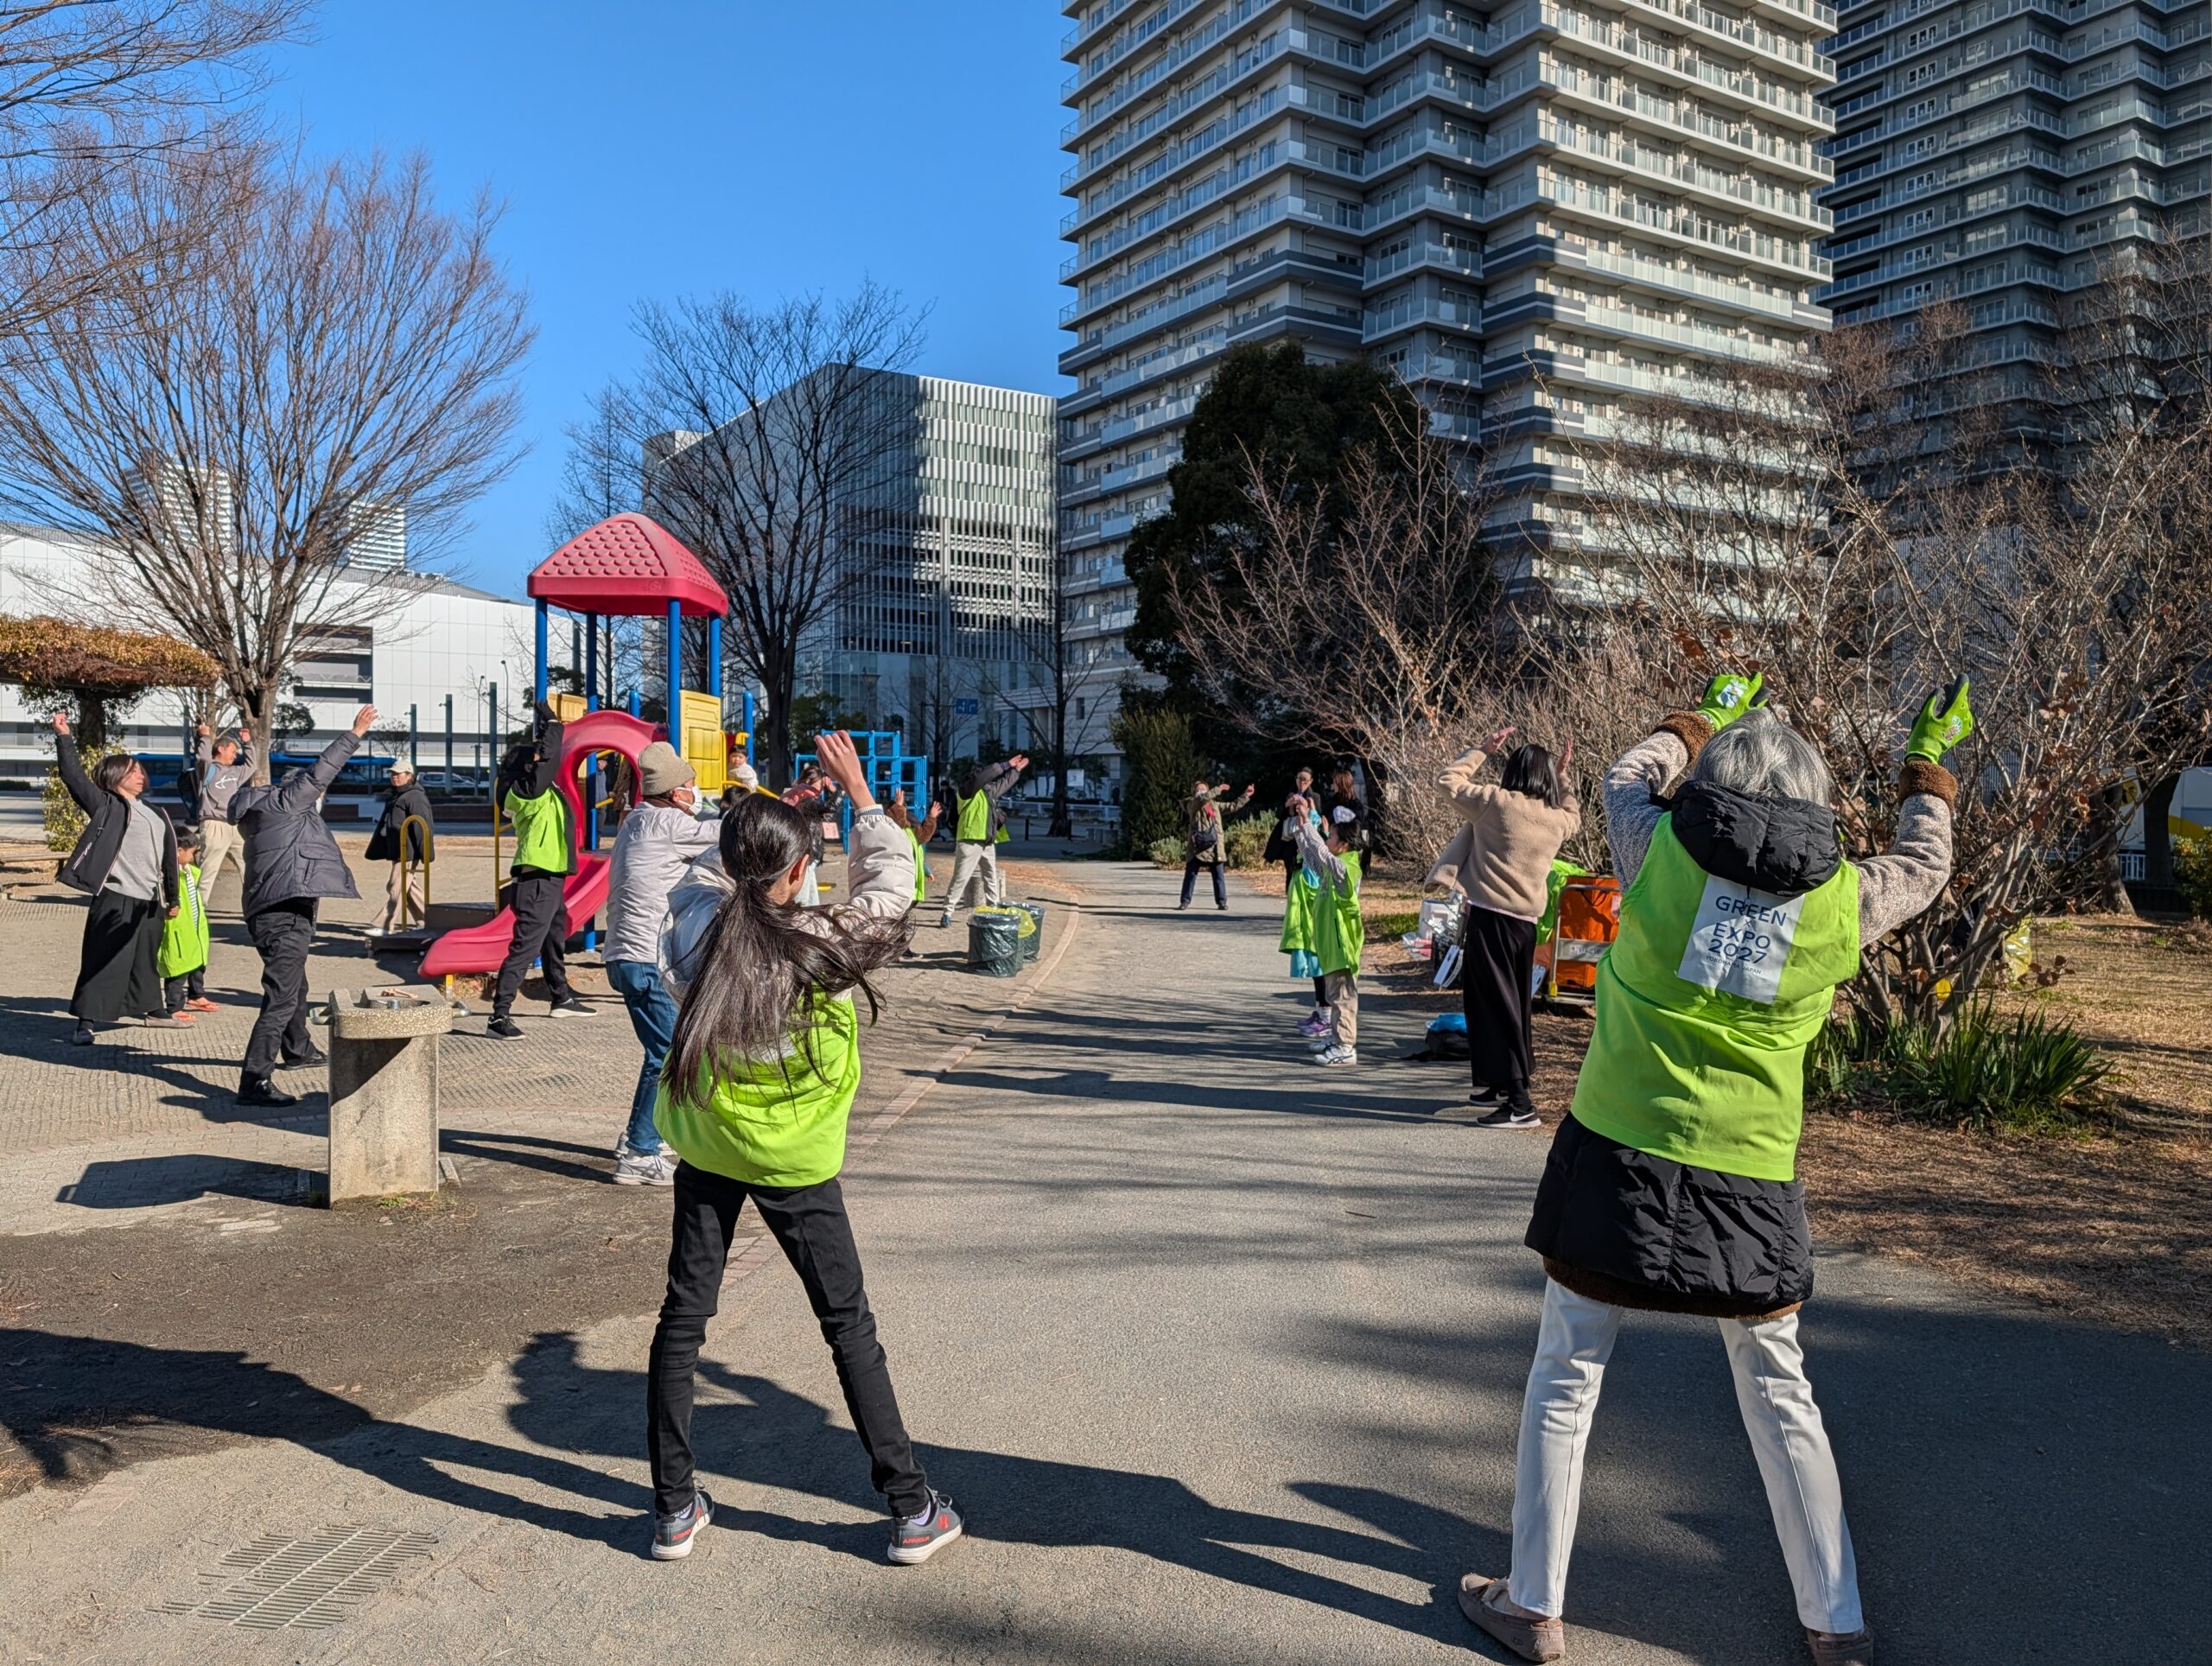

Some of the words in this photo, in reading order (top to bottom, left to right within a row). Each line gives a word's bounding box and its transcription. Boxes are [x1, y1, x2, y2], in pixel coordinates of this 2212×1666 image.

[1715, 895, 1787, 926] GREEN
[1713, 922, 1770, 949] EXPO
[1708, 938, 1767, 964] 2027
[1706, 955, 1740, 969] YOKOHAMA
[1742, 966, 1762, 975] JAPAN
